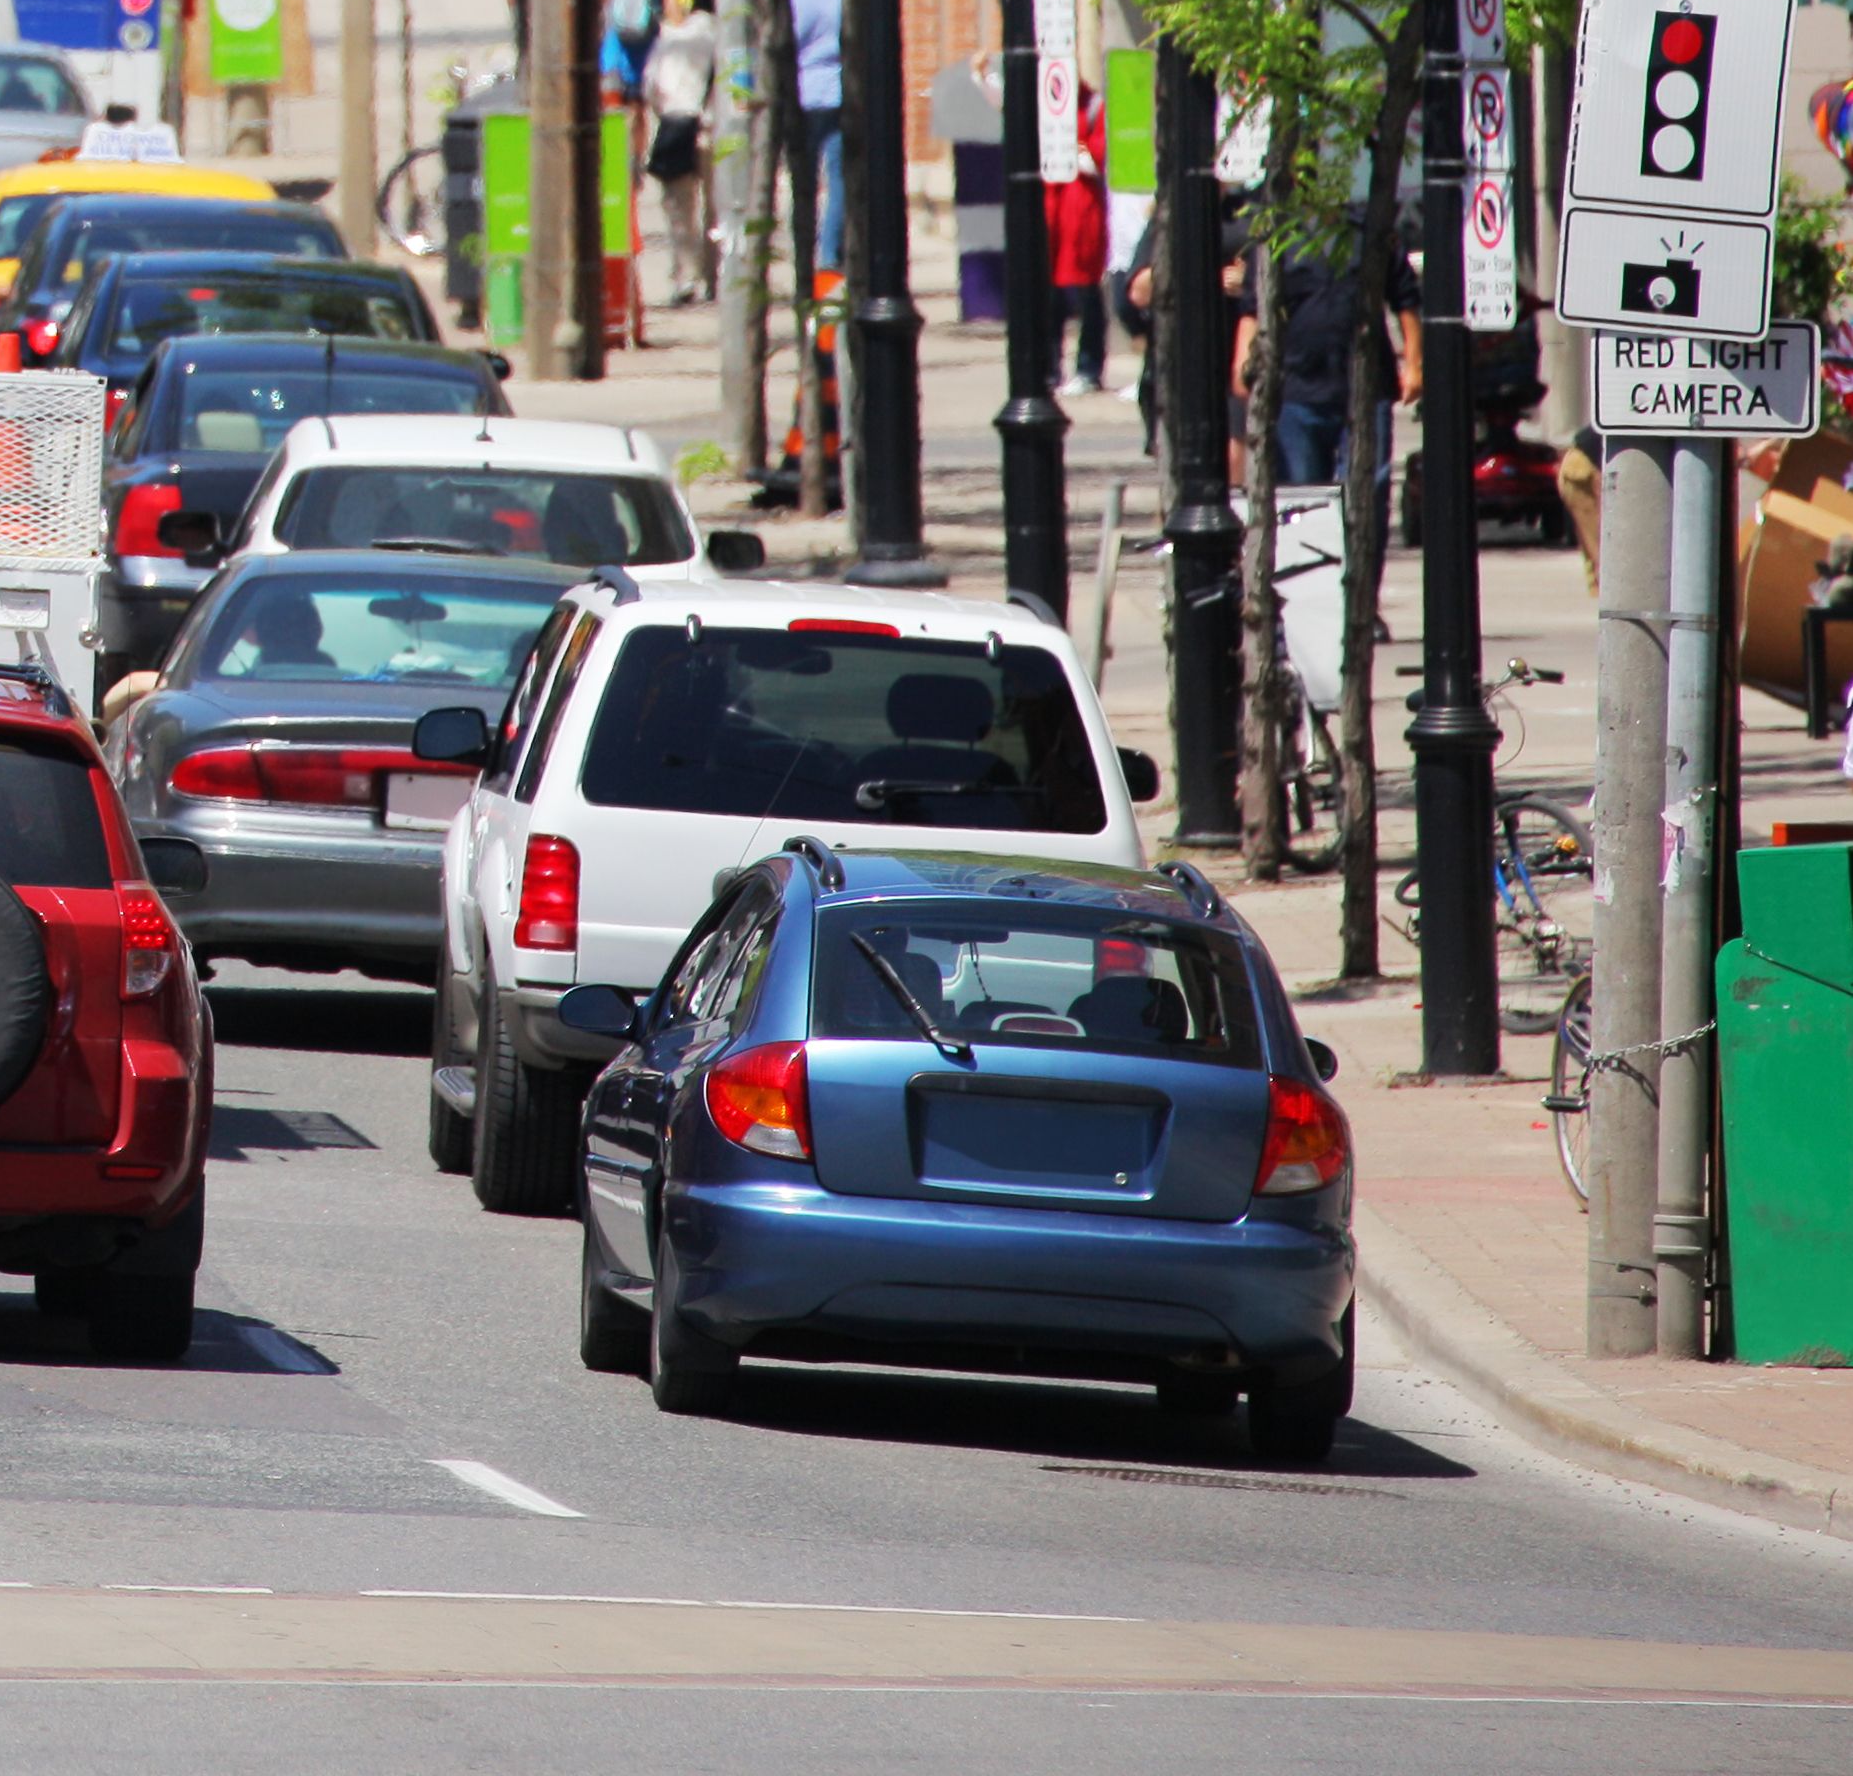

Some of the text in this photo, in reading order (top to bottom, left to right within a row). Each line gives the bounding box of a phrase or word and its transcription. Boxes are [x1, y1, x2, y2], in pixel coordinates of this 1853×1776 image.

[1615, 337, 1789, 370] RED LIGHT
[1630, 383, 1772, 417] CAMERA
